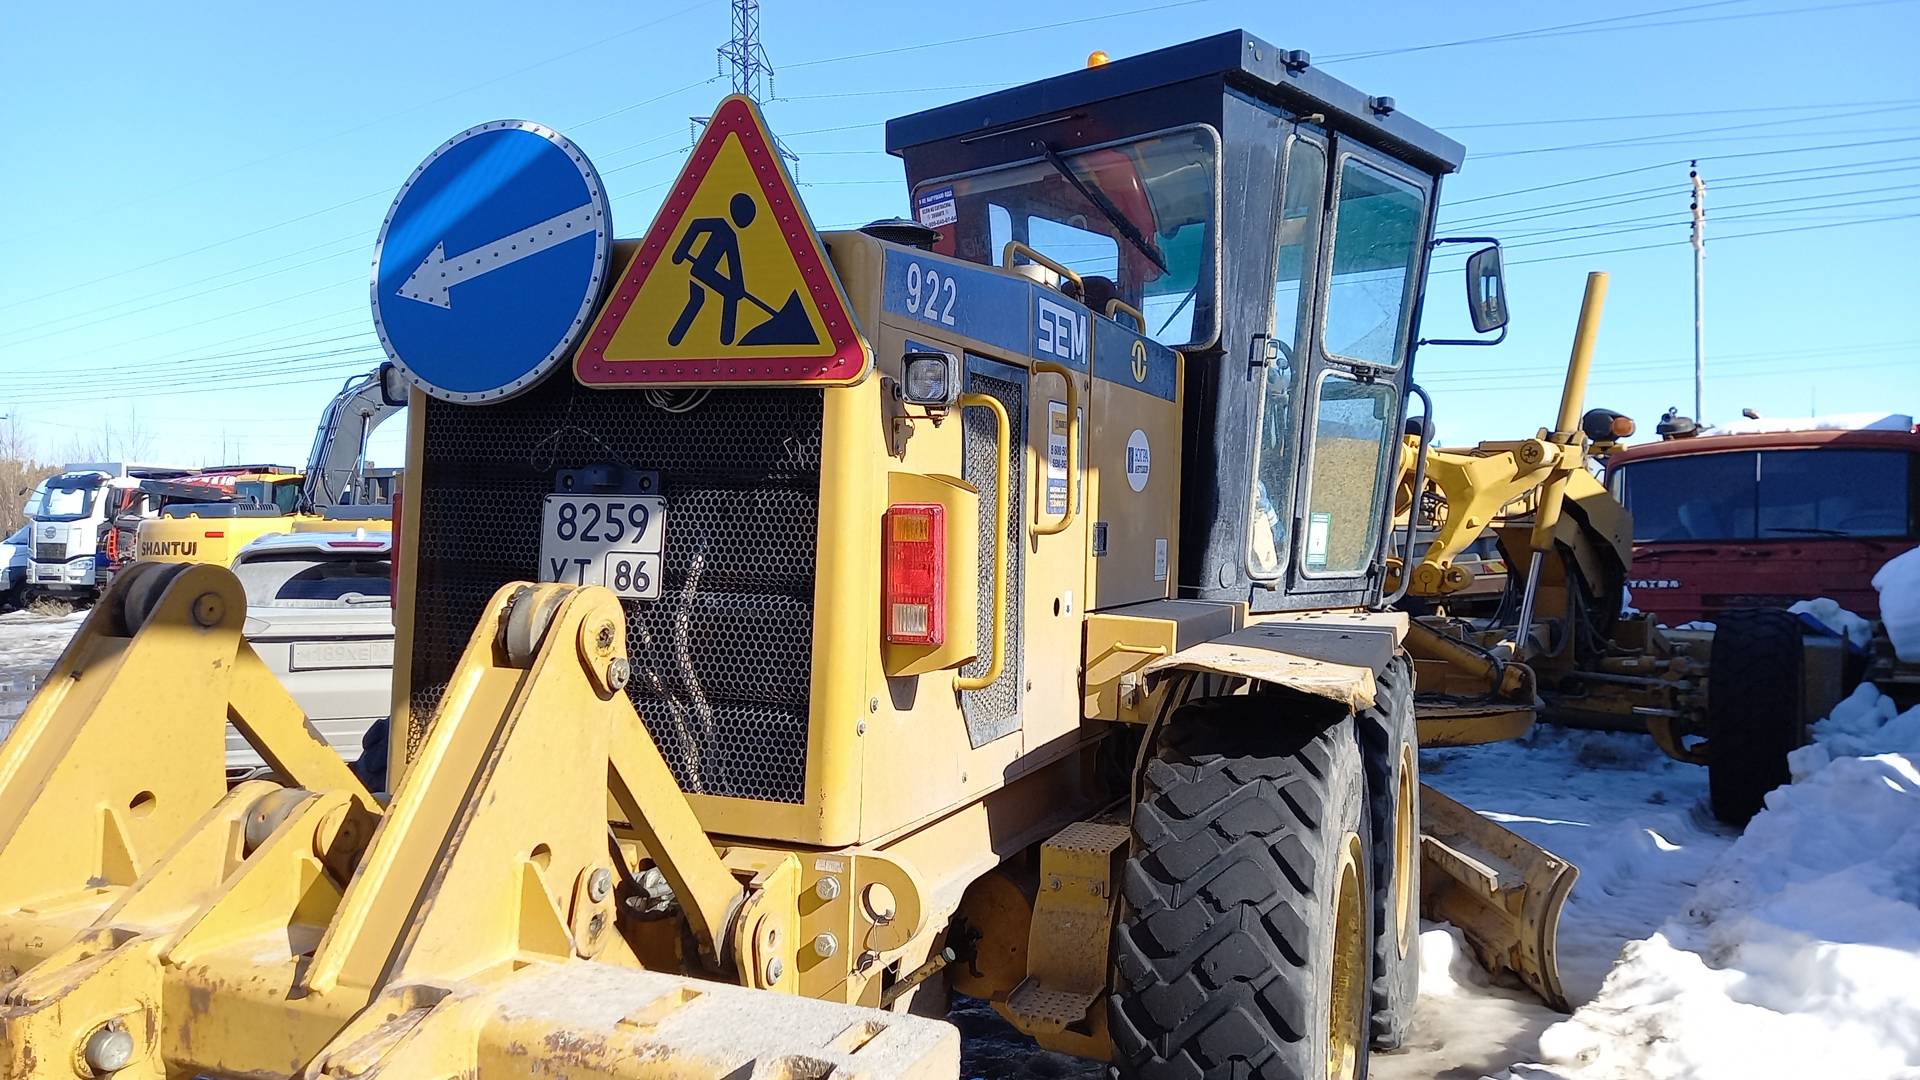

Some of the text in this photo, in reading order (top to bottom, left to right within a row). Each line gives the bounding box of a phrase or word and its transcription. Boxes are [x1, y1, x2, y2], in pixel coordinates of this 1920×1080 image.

[906, 262, 957, 326] 922
[1038, 298, 1087, 365] SEM
[556, 502, 650, 544] 8259
[141, 541, 198, 556] SHANTUI
[614, 560, 651, 593] 86
[1630, 580, 1680, 589] TATRA
